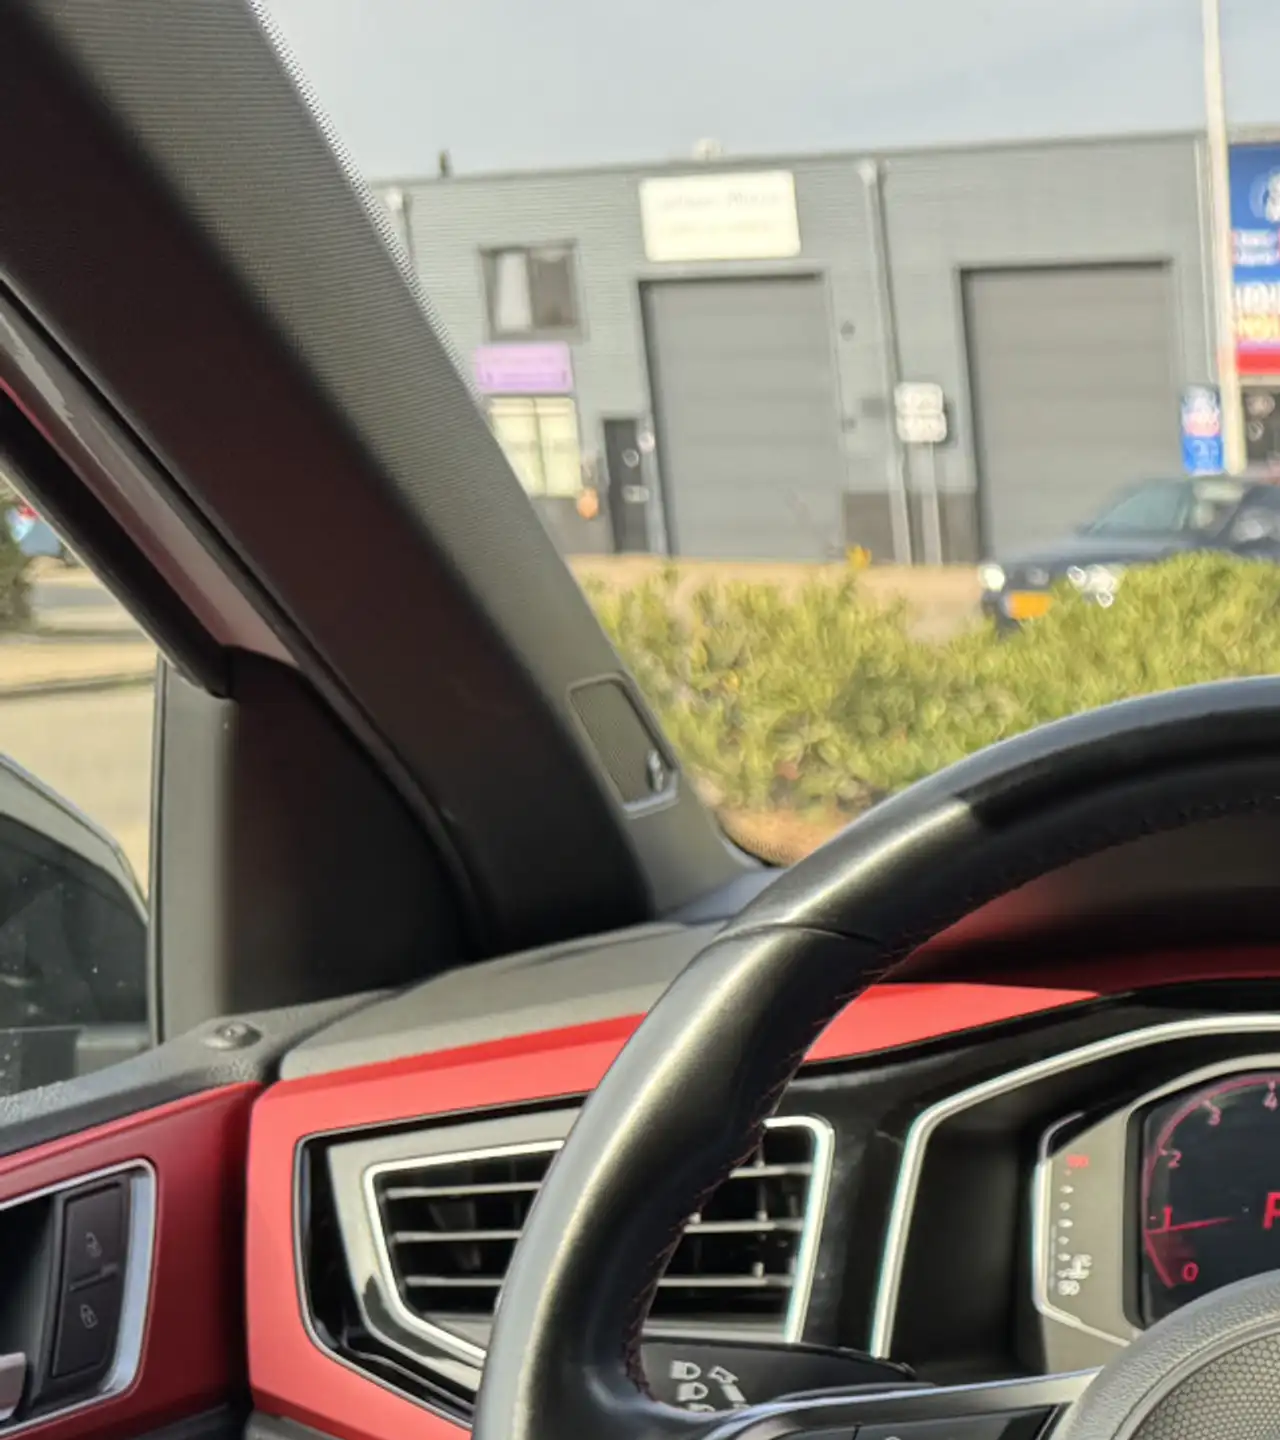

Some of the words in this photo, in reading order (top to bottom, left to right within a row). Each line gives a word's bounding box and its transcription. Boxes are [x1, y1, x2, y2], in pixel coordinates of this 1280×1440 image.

[1263, 1094, 1278, 1112] 4
[1207, 1108, 1222, 1126] 3
[1167, 1152, 1182, 1169] 2
[1181, 1262, 1199, 1282] 0
